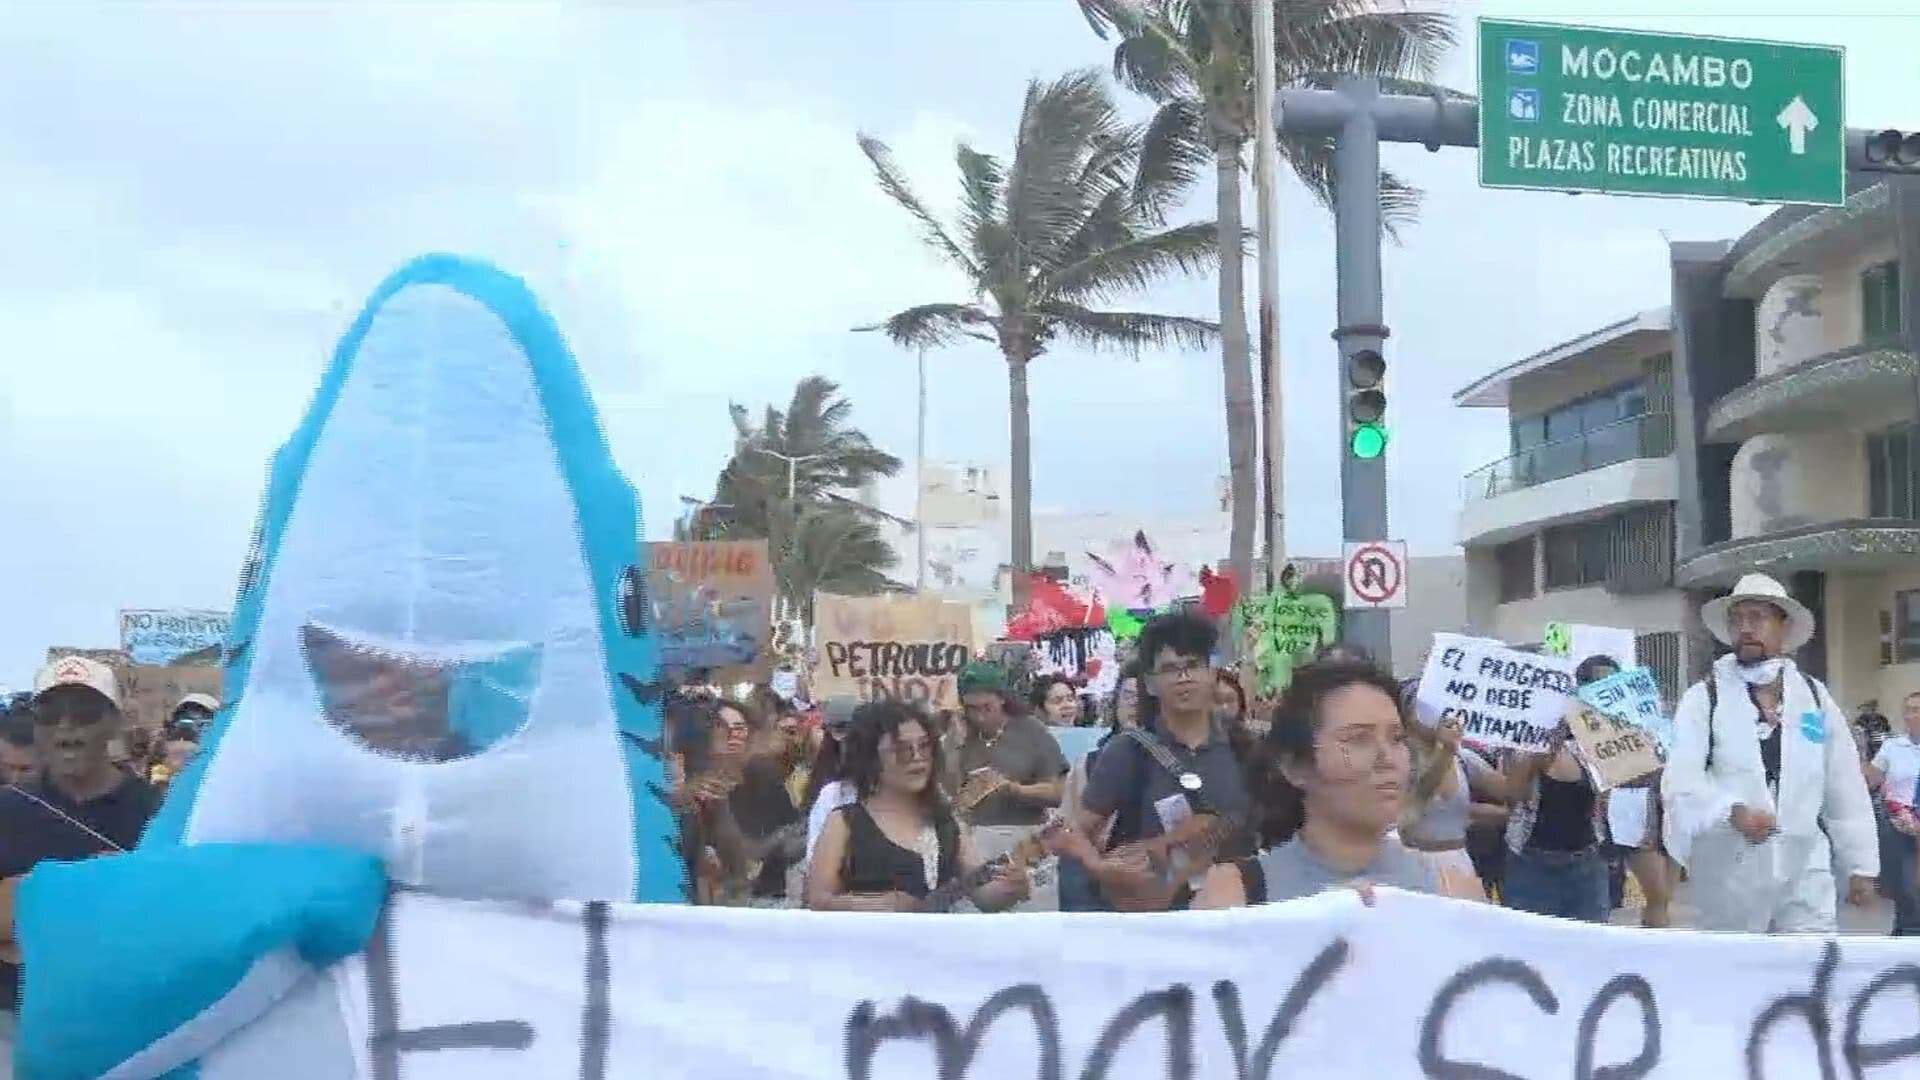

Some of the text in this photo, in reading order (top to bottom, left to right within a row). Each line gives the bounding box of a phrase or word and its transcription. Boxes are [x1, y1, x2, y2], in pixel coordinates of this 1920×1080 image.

[1561, 45, 1753, 89] MOCAMBO
[1562, 92, 1753, 136] ZONA COMERCIAL
[1509, 137, 1747, 182] PLAZAS RECREATIVAS
[825, 640, 969, 678] PETROLEO
[1441, 649, 1466, 671] EL
[1445, 679, 1533, 710] NO DEBE
